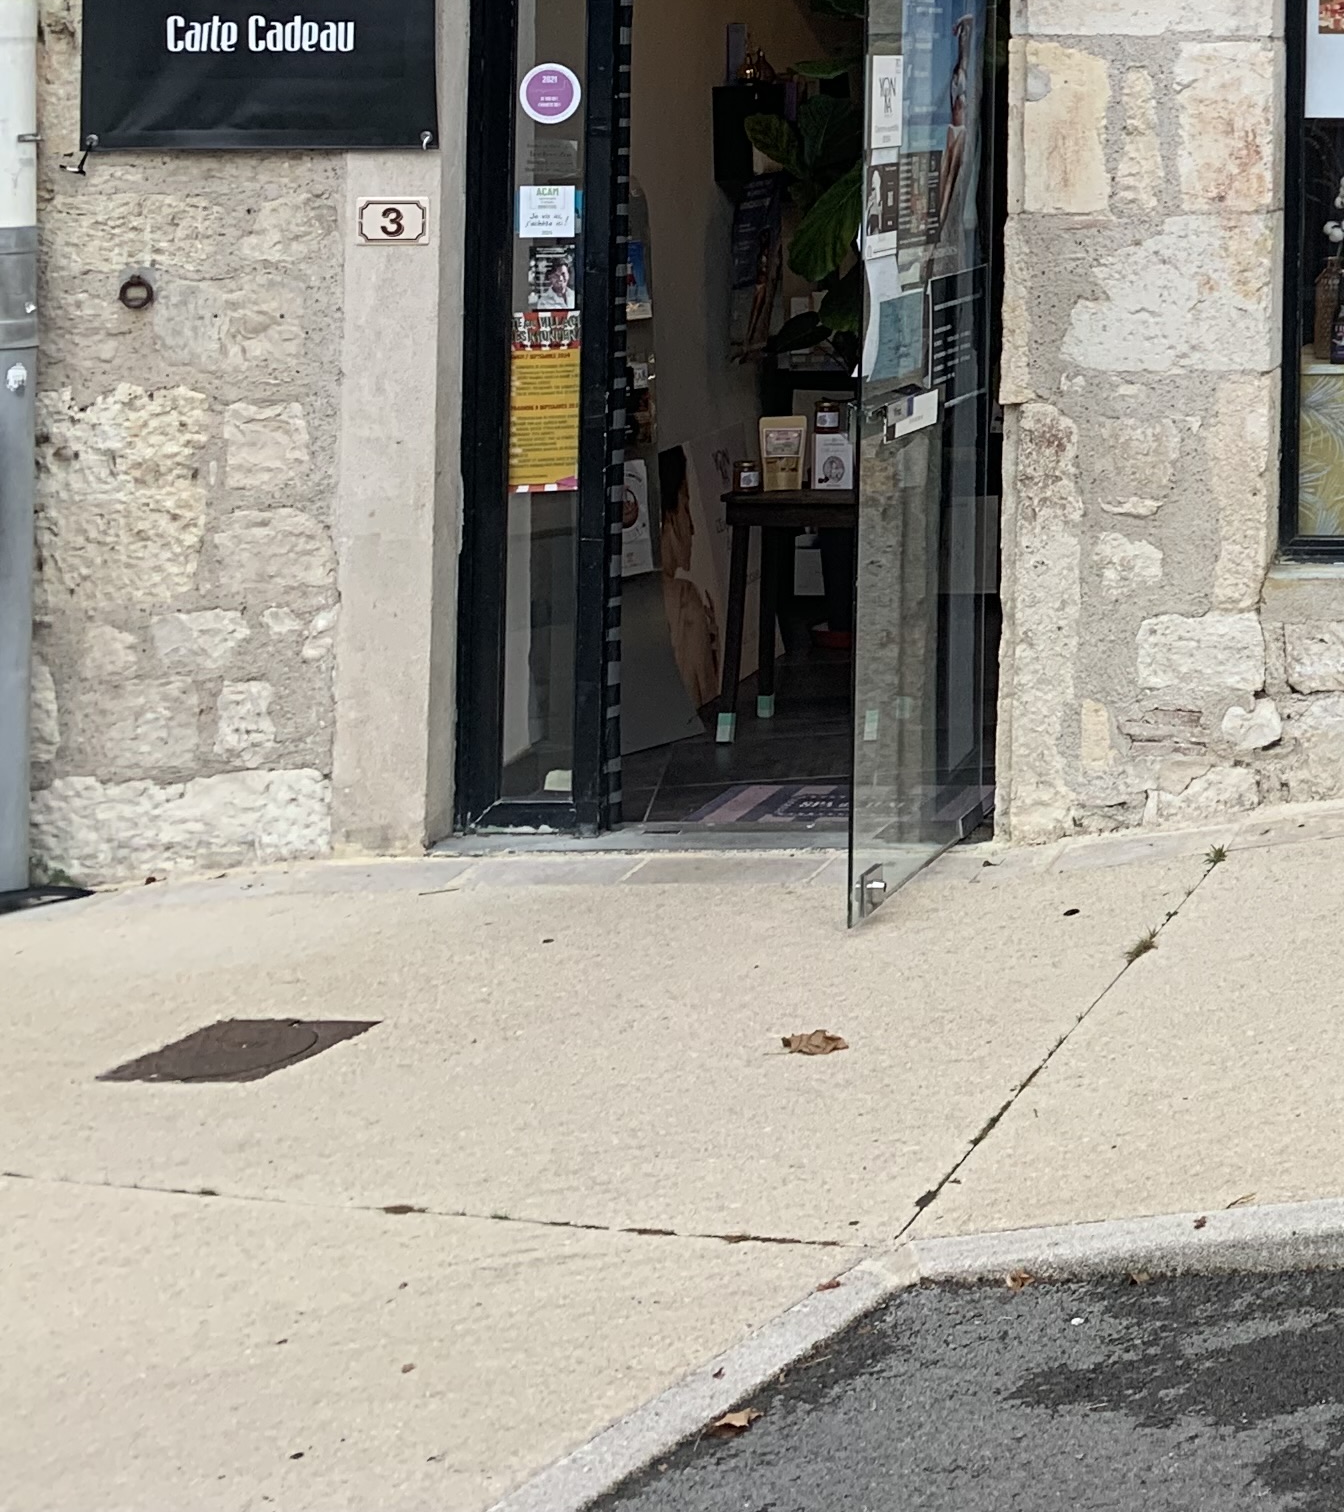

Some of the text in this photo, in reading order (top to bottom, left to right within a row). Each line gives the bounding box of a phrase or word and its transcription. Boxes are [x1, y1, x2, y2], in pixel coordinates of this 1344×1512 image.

[167, 16, 354, 51] Carte Cadeau
[536, 187, 559, 196] ACAM
[381, 208, 404, 237] 3
